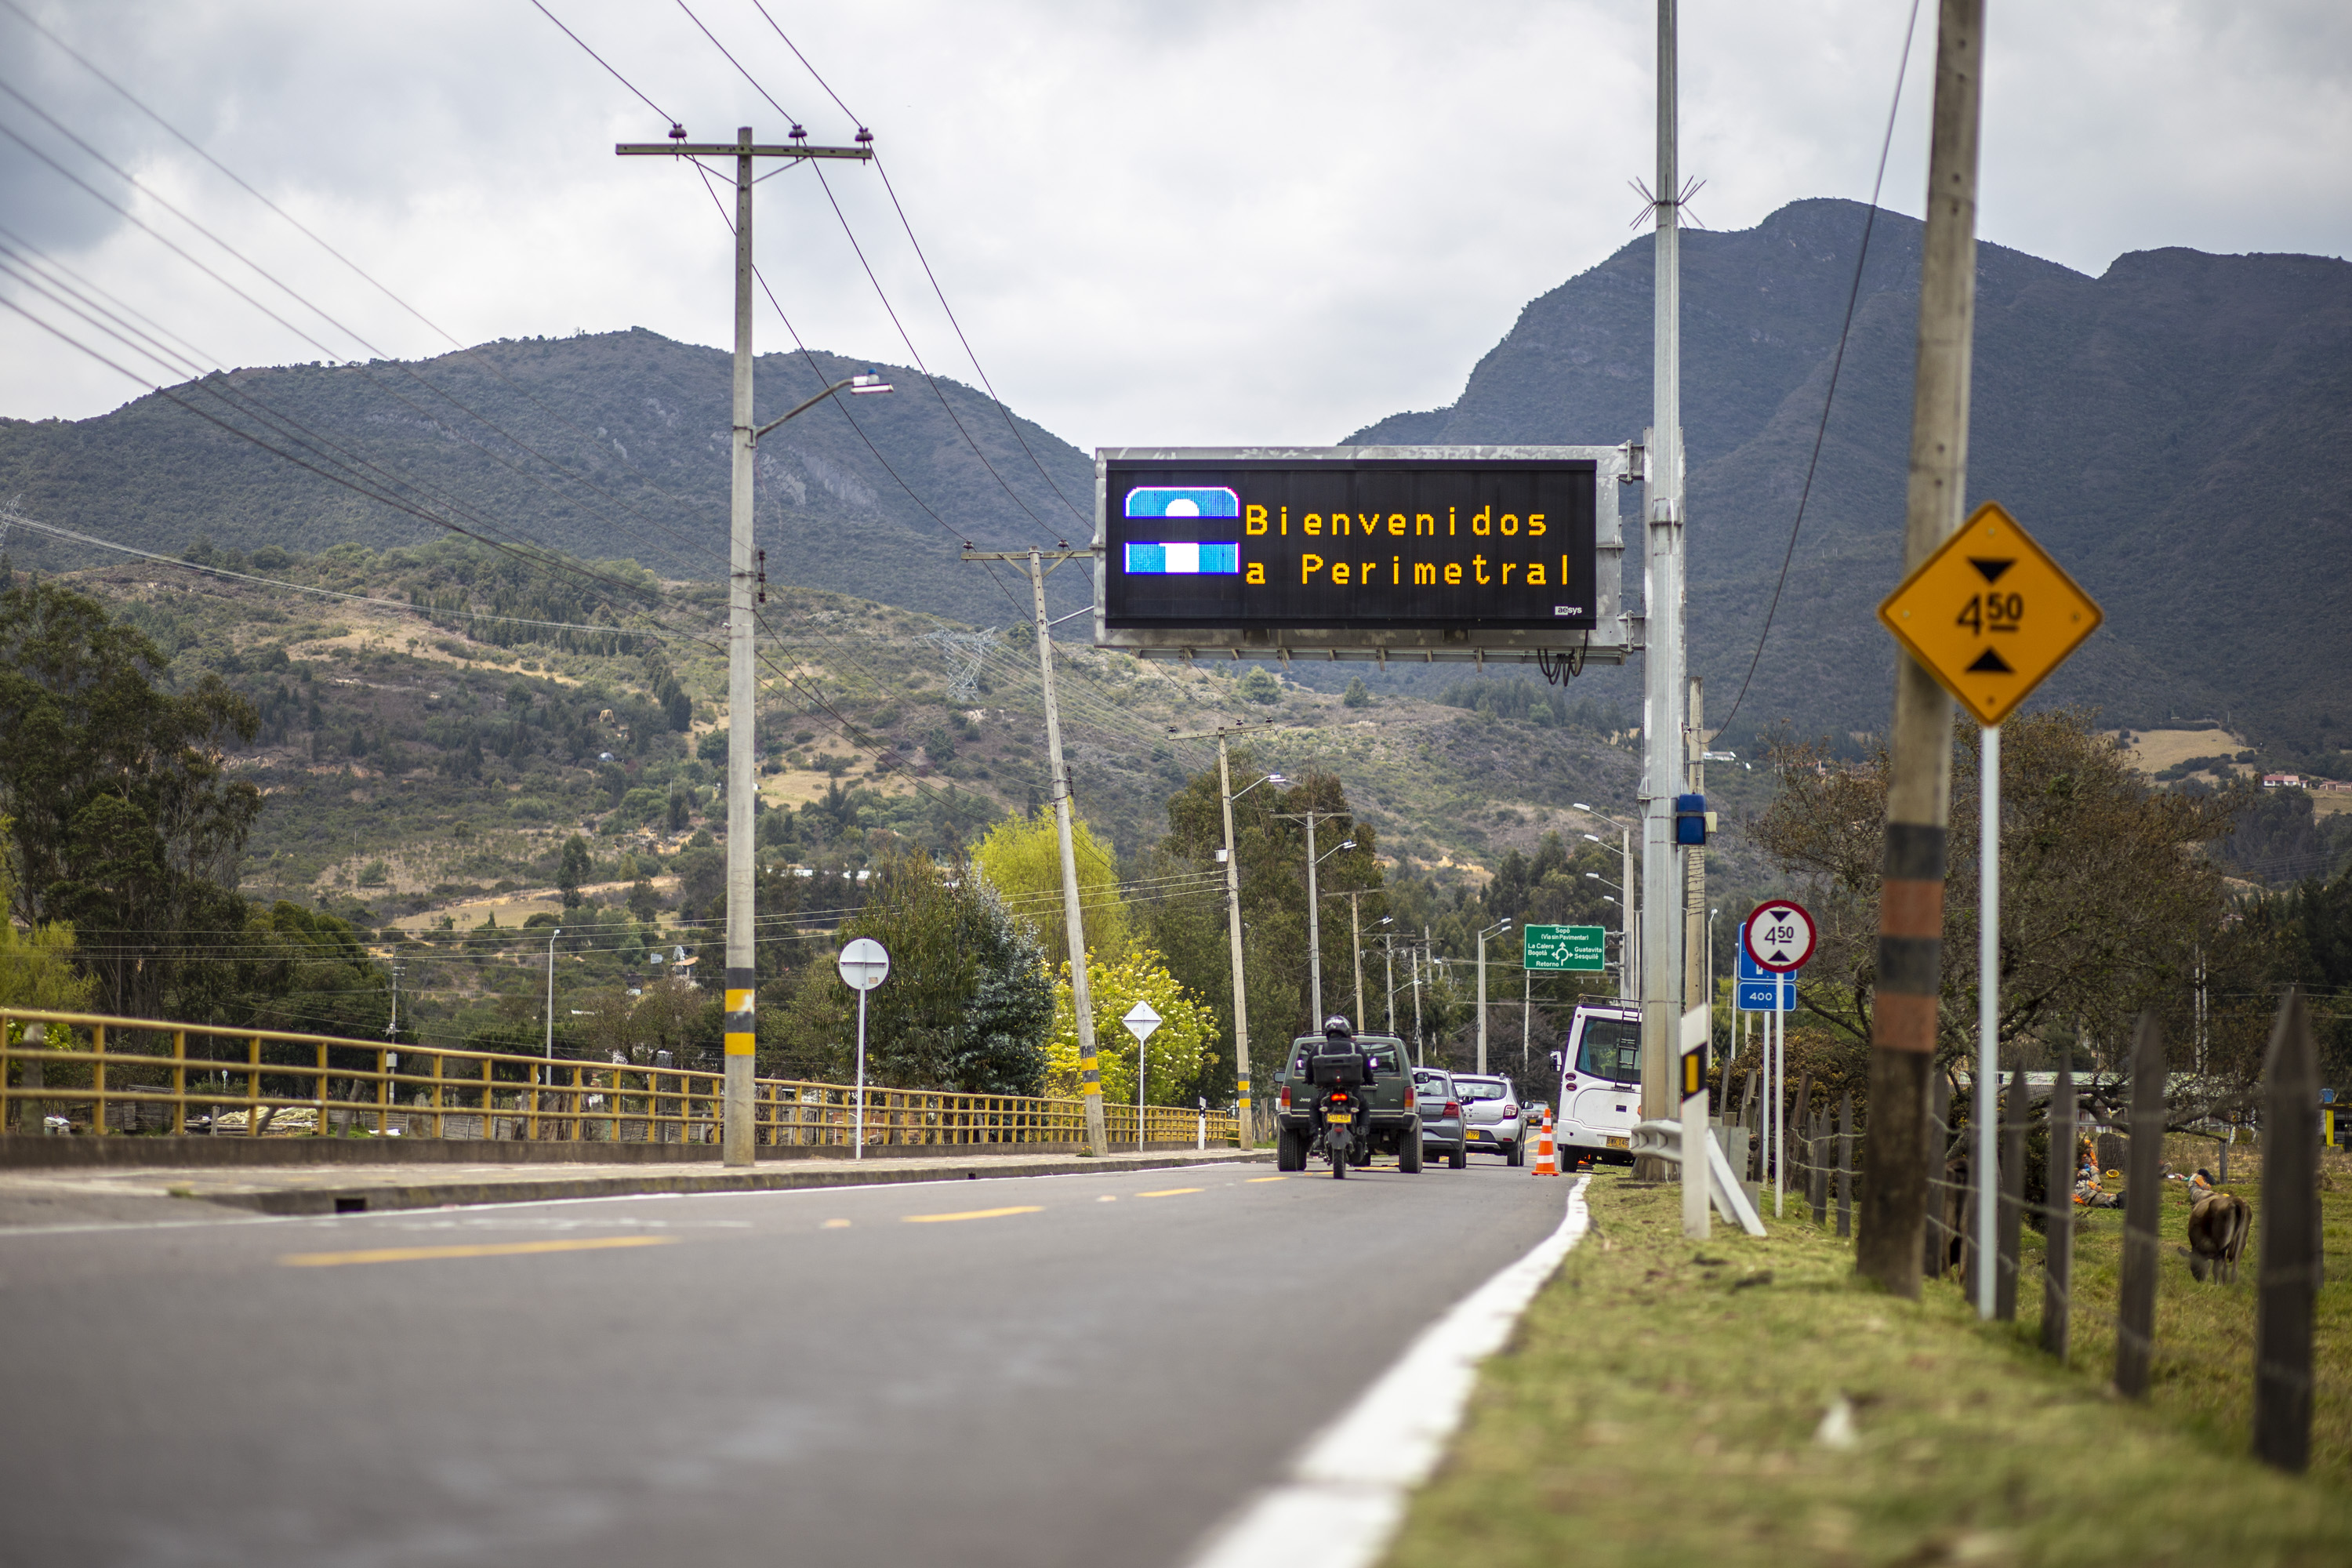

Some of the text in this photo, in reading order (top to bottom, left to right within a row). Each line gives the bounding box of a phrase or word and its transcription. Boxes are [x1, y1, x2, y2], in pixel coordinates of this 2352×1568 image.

[1245, 504, 1548, 536] Bienvenidos
[1245, 554, 1569, 586] a Perimetral
[1558, 607, 1582, 615] aesys
[1749, 993, 1773, 1001] 400
